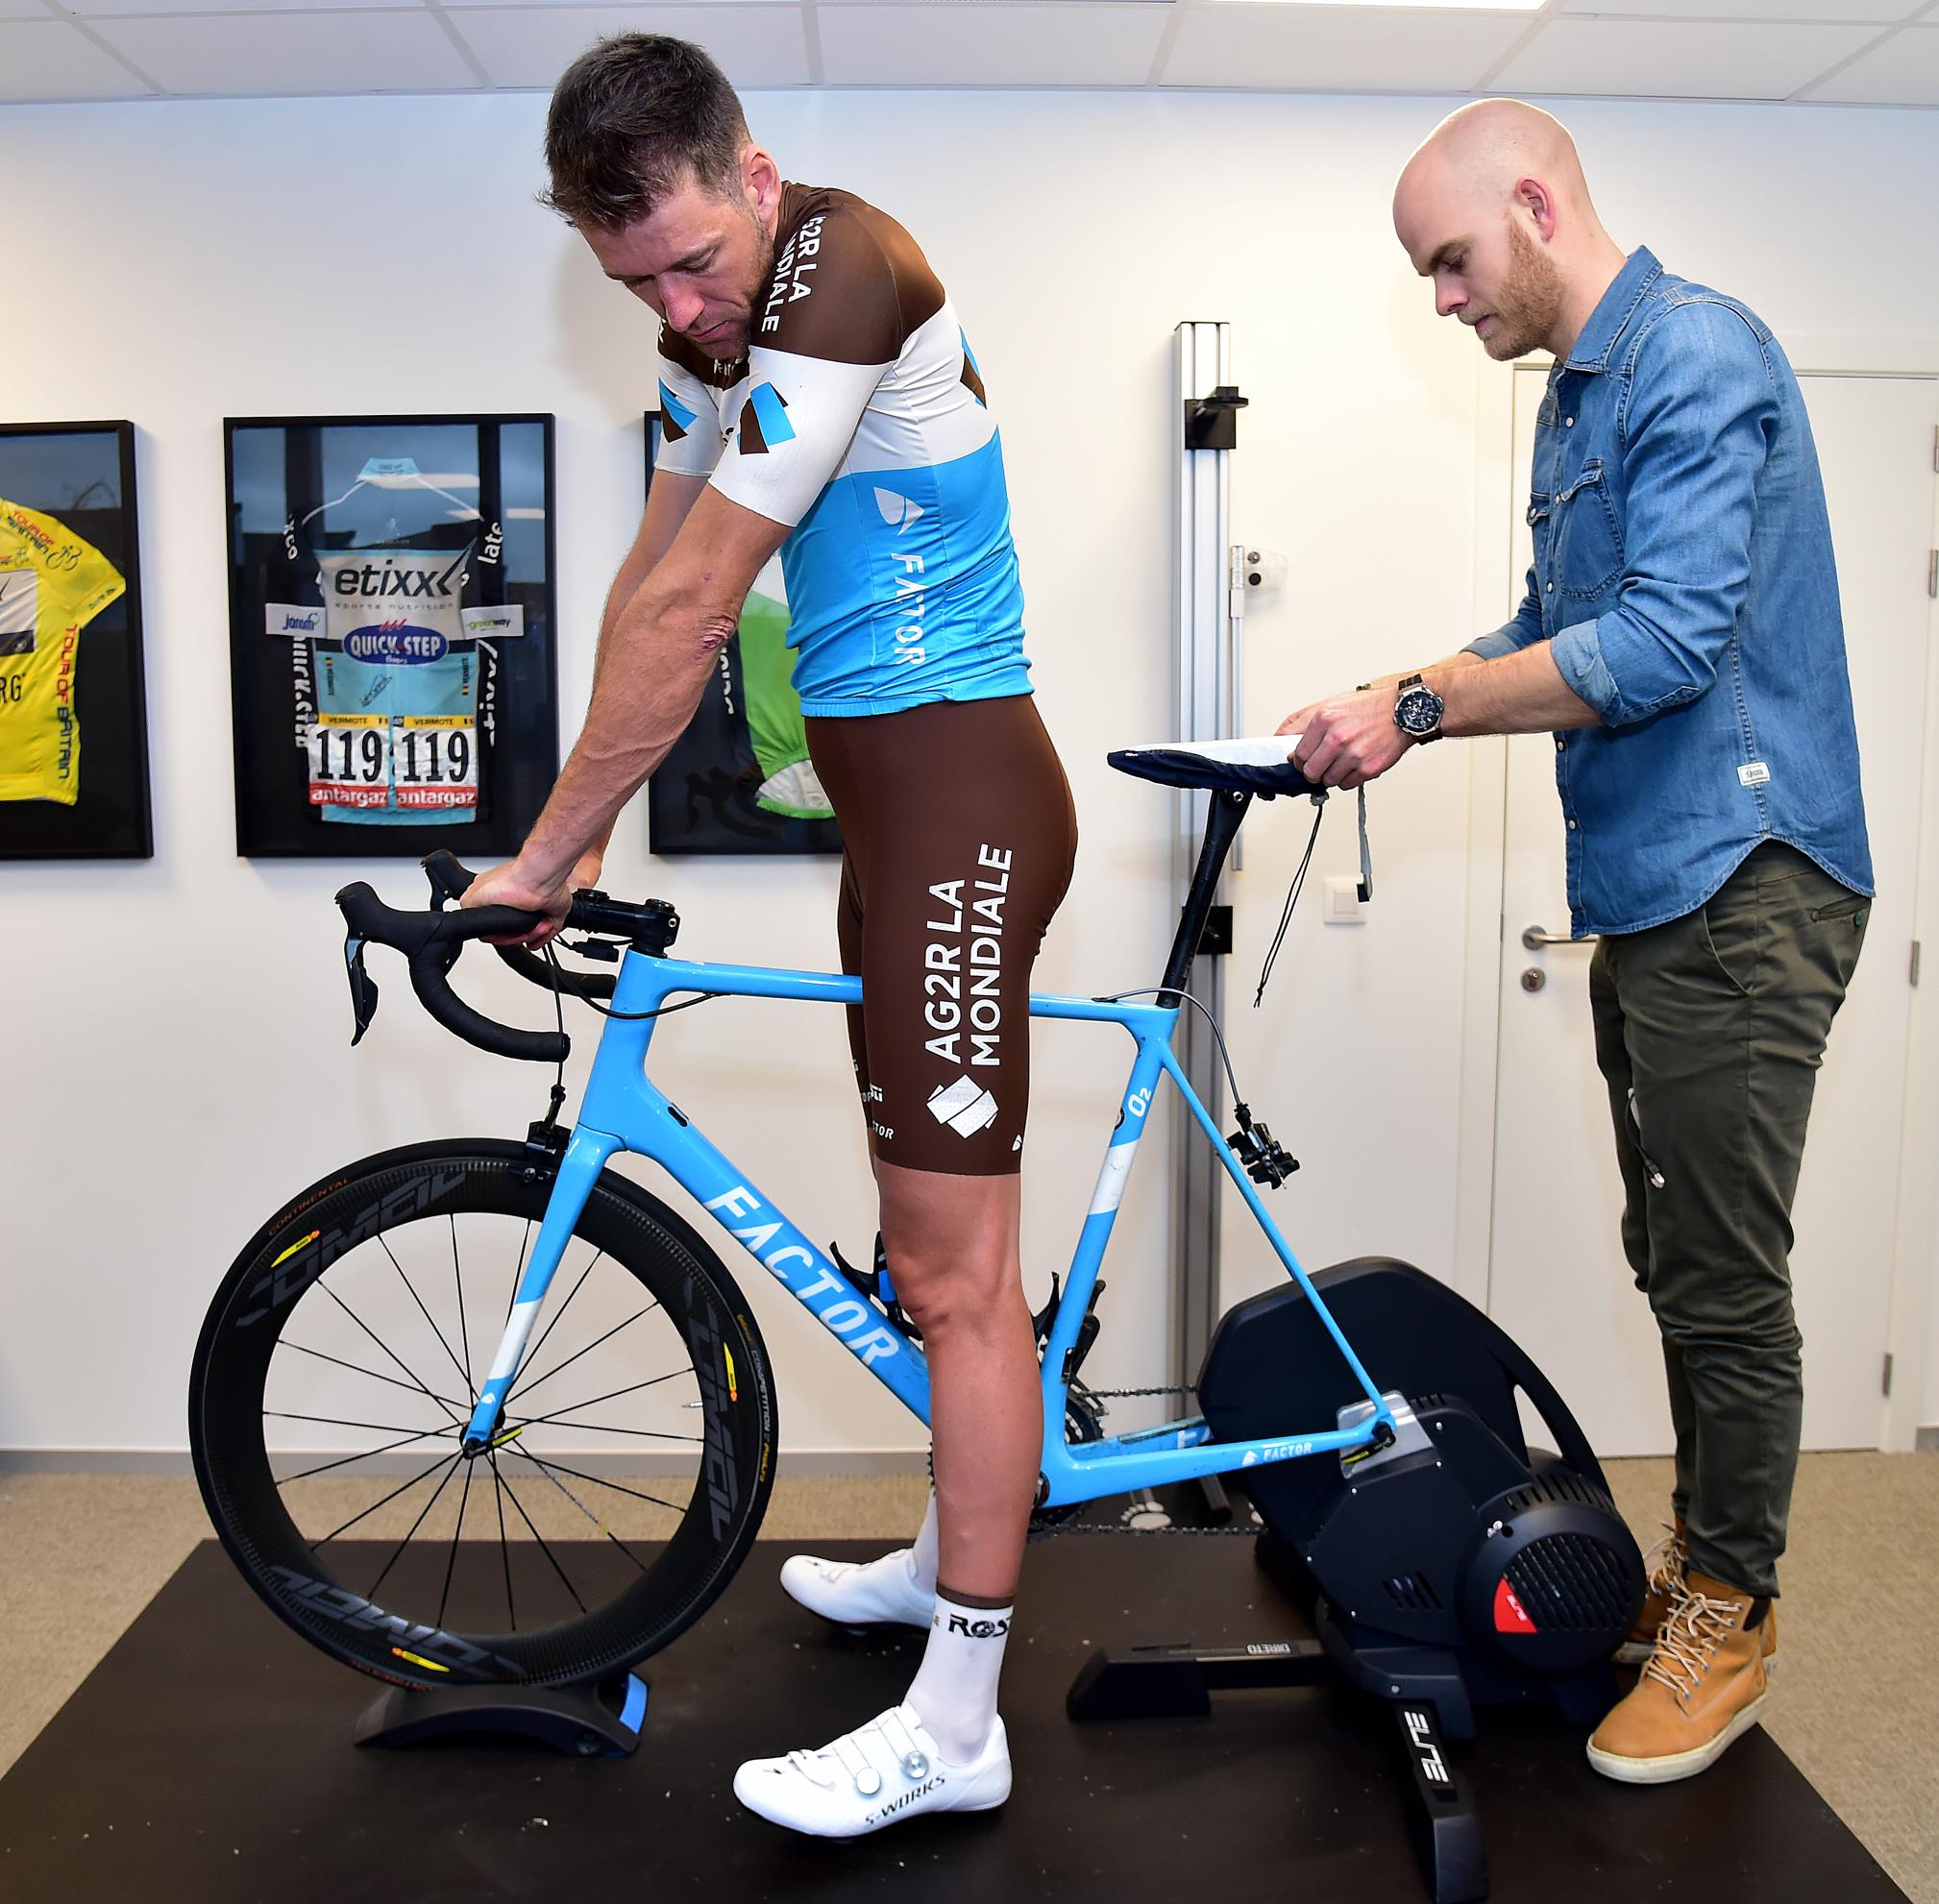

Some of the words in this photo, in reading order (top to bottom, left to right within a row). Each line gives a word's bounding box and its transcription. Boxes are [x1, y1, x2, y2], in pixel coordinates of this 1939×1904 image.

[788, 262, 818, 303] LA
[335, 559, 440, 597] etixx
[891, 552, 930, 666] FATOR
[59, 624, 78, 675] TOUR
[57, 678, 69, 704] OF
[328, 717, 369, 725] VERMOTE
[316, 729, 383, 783] 119
[402, 731, 469, 783] 119
[312, 788, 388, 807] antargaz
[397, 790, 476, 808] antargaz
[926, 879, 966, 933] LA
[969, 843, 1013, 1066] MONDIALE
[924, 941, 962, 1065] AG2R
[702, 1185, 900, 1366] FACTOR
[1264, 1442, 1313, 1461] FACTOR
[866, 1772, 945, 1824] S-WORKS
